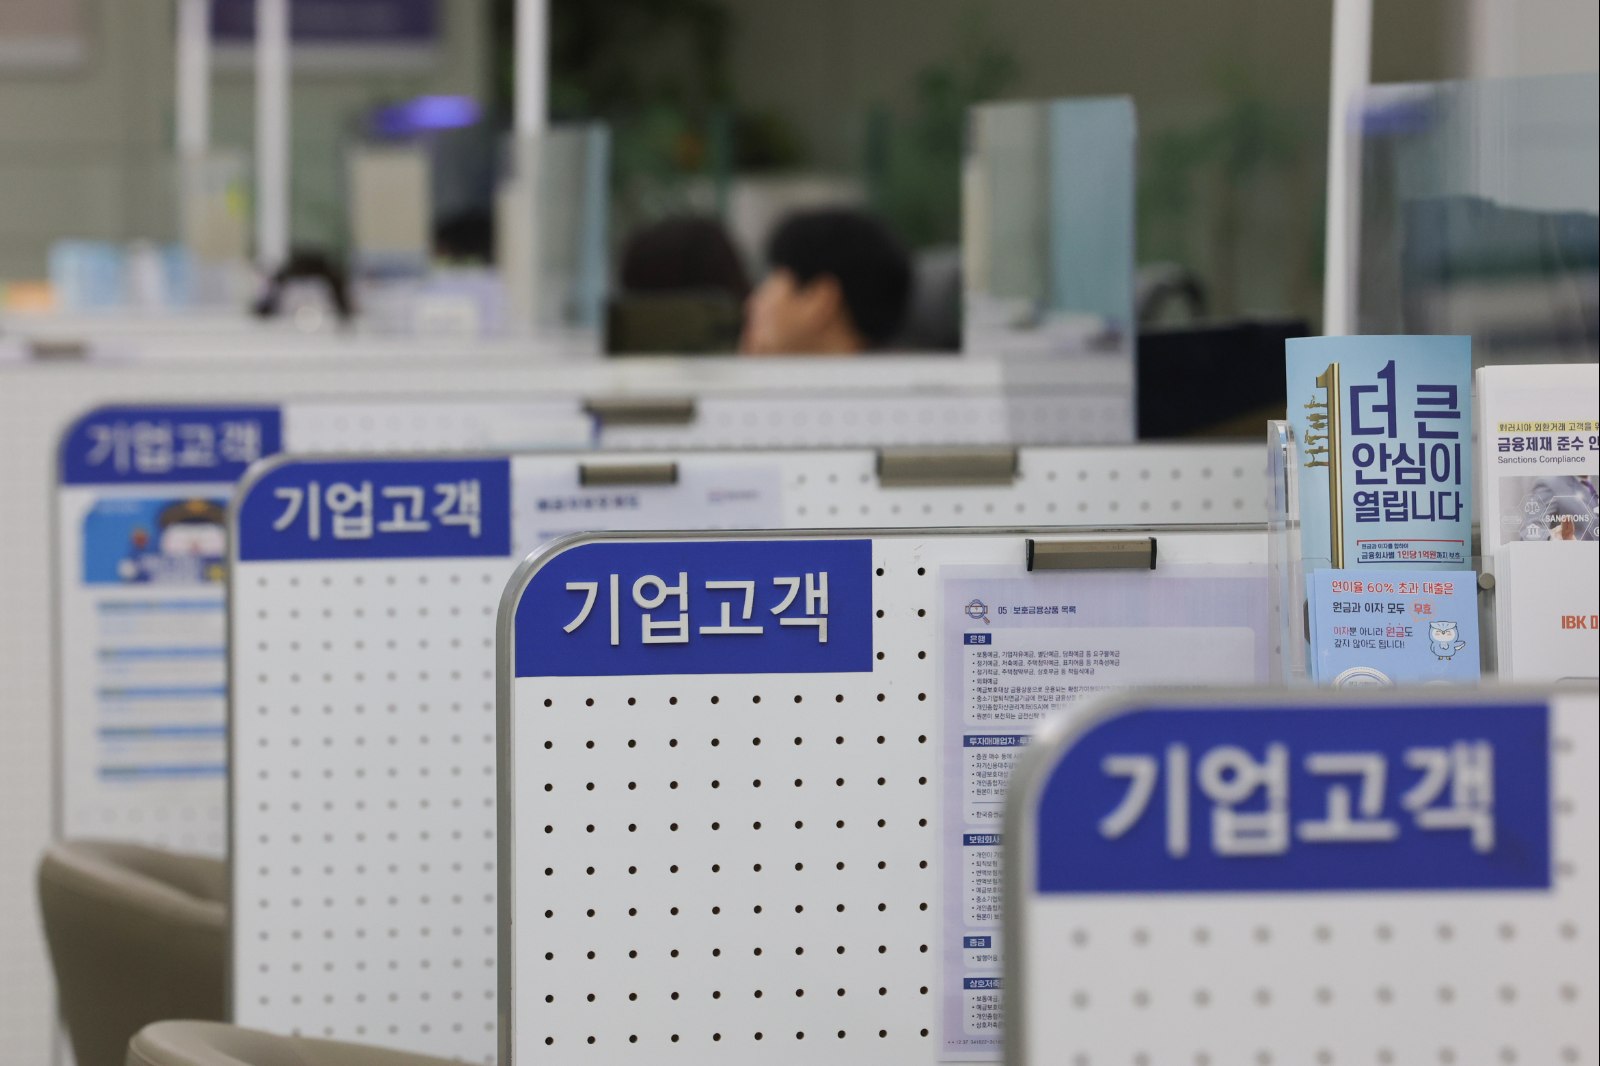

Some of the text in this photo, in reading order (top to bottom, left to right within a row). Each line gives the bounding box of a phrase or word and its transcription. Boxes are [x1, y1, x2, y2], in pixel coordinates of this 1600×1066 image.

[1350, 360, 1460, 439] 더 큰
[86, 420, 261, 473] 기업고객
[1498, 436, 1552, 452] 금융제재
[1557, 436, 1584, 451] 준수
[1352, 443, 1461, 485] 안심이
[1498, 455, 1586, 465] Sanctions Compliance
[273, 481, 482, 541] 기업고객
[1353, 491, 1463, 522] 열립니다
[1545, 514, 1590, 523] SANCTIONS
[1361, 551, 1395, 560] 금융회사별
[1397, 550, 1417, 559] 1인당
[1332, 581, 1454, 595] 연이율 60% 초과 대출은
[563, 572, 830, 646] 기업고객
[998, 605, 1077, 615] 05 보호금융상품 목록
[1333, 602, 1432, 615] 원금과 이자 모두 무효
[1561, 615, 1588, 630] IBK
[1333, 627, 1413, 638] 이자뿐 아니라 원금도
[970, 635, 986, 644] 은행
[1353, 639, 1377, 650] 않아도
[1379, 639, 1406, 650] 됩니다!
[1099, 740, 1495, 858] 기업고객
[969, 836, 1000, 844] 보험회사
[970, 938, 985, 947] 종금
[970, 980, 1003, 989] 상호저축
